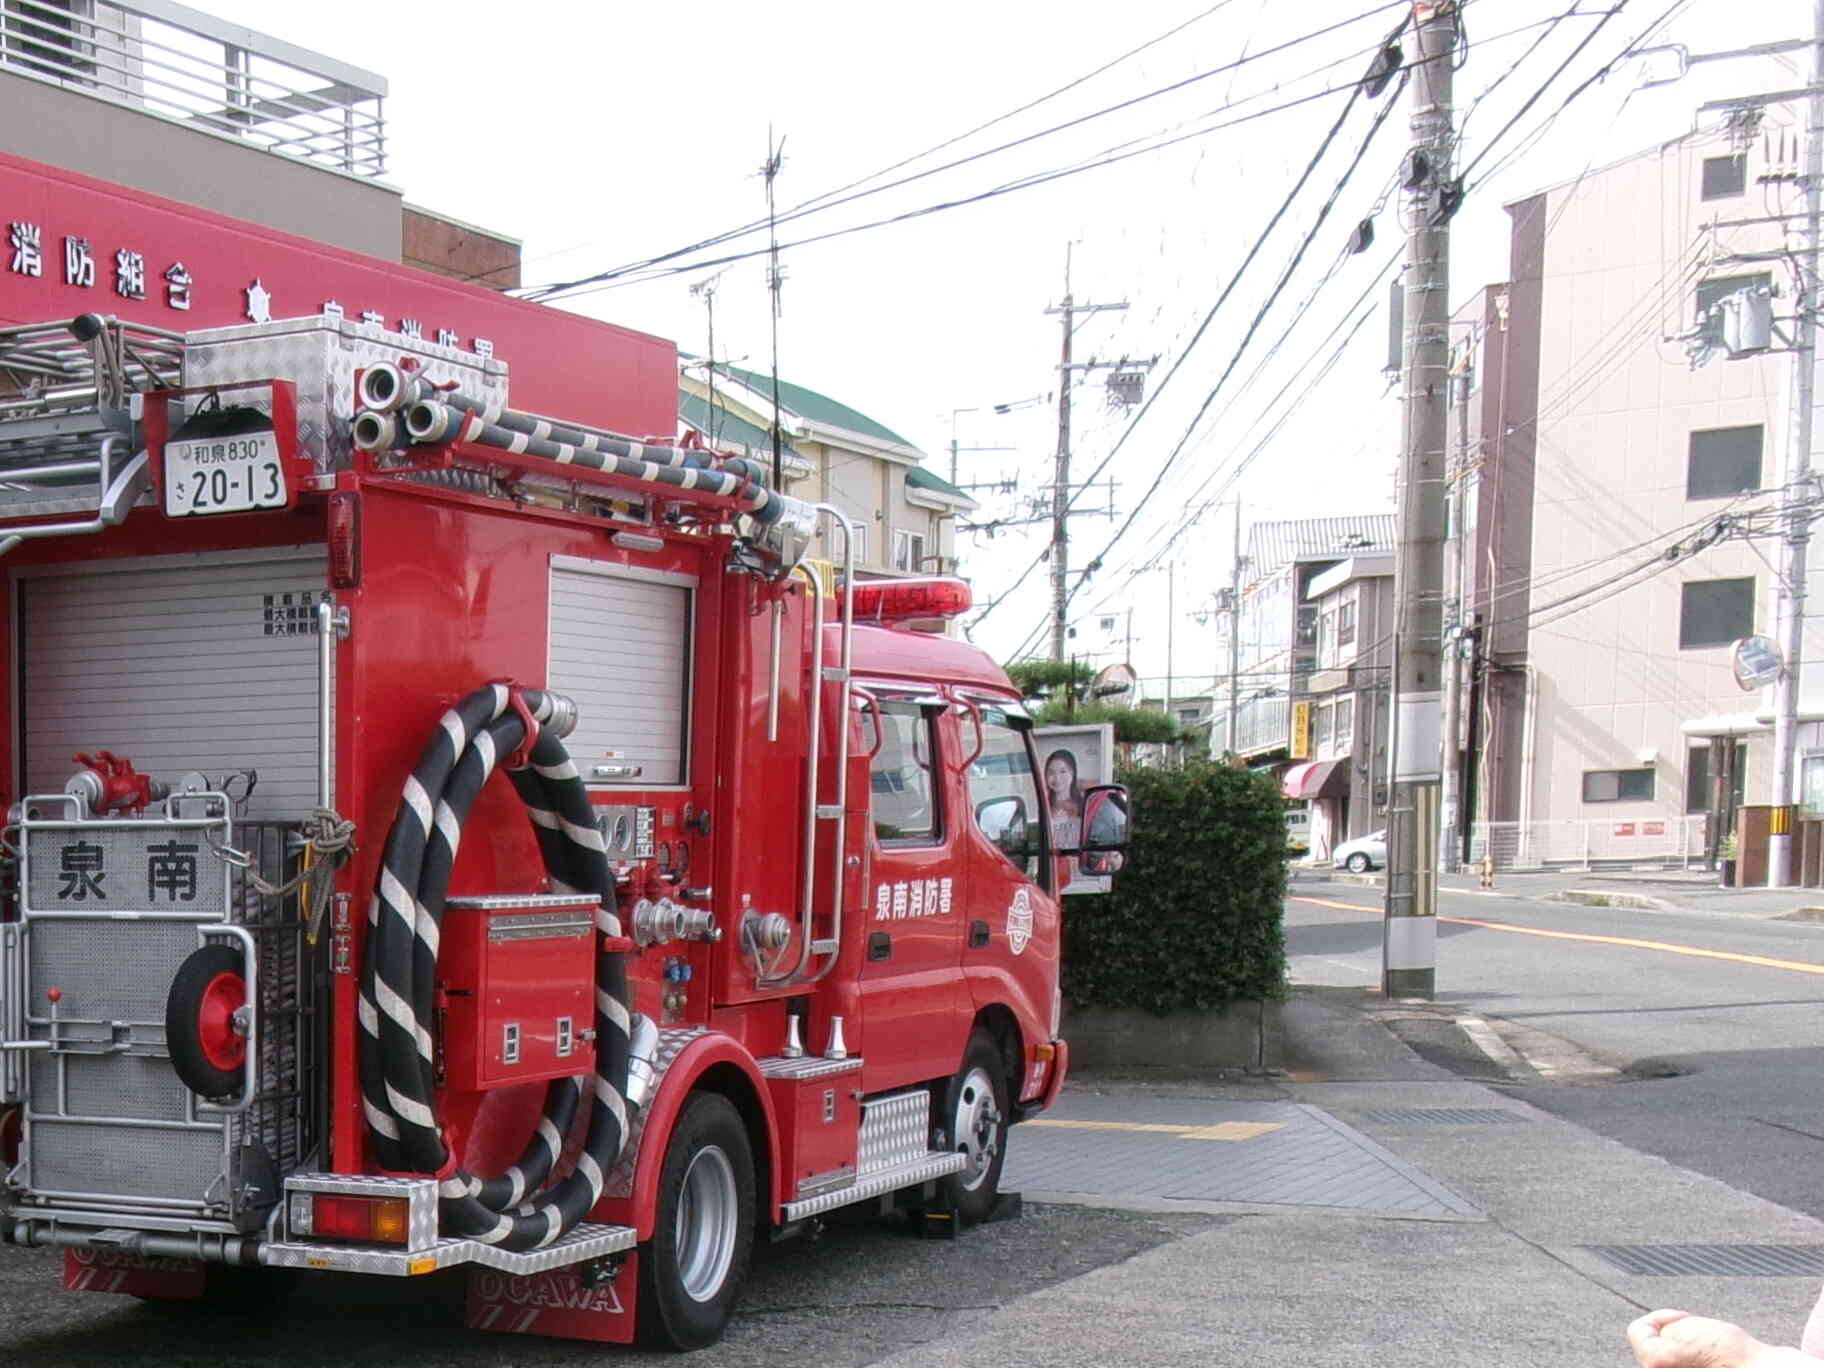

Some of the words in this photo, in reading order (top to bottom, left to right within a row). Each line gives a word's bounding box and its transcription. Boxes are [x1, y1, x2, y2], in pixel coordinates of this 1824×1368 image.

[194, 444, 225, 464] 和泉
[228, 440, 258, 460] 830
[191, 462, 279, 508] 20-13
[57, 839, 200, 901] 泉南
[876, 876, 953, 921] 泉南消防署
